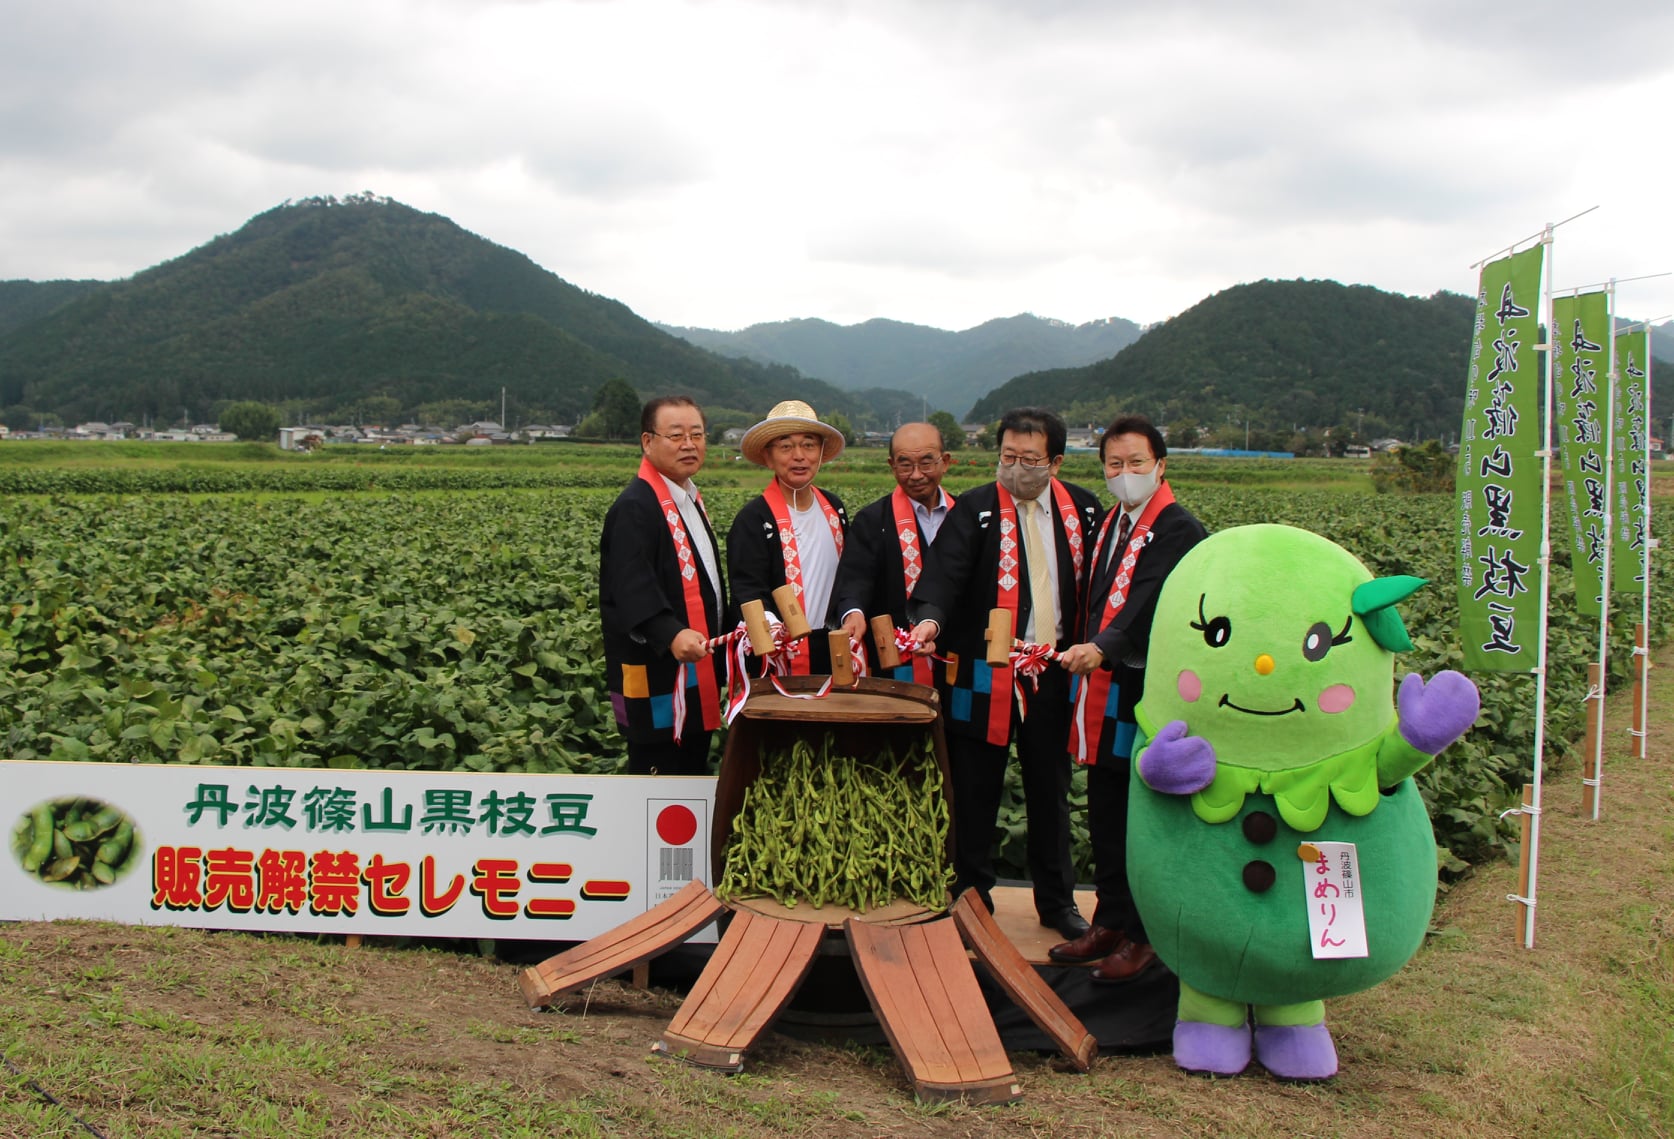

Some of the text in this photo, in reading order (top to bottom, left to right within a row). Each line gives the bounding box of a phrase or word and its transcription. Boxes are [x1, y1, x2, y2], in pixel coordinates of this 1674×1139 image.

[184, 783, 598, 838] 丹波篠山黒枝豆
[151, 846, 631, 920] 販売解禁セレモニー
[1314, 851, 1345, 947] まめりん
[1340, 851, 1354, 898] 丹波篠山市
